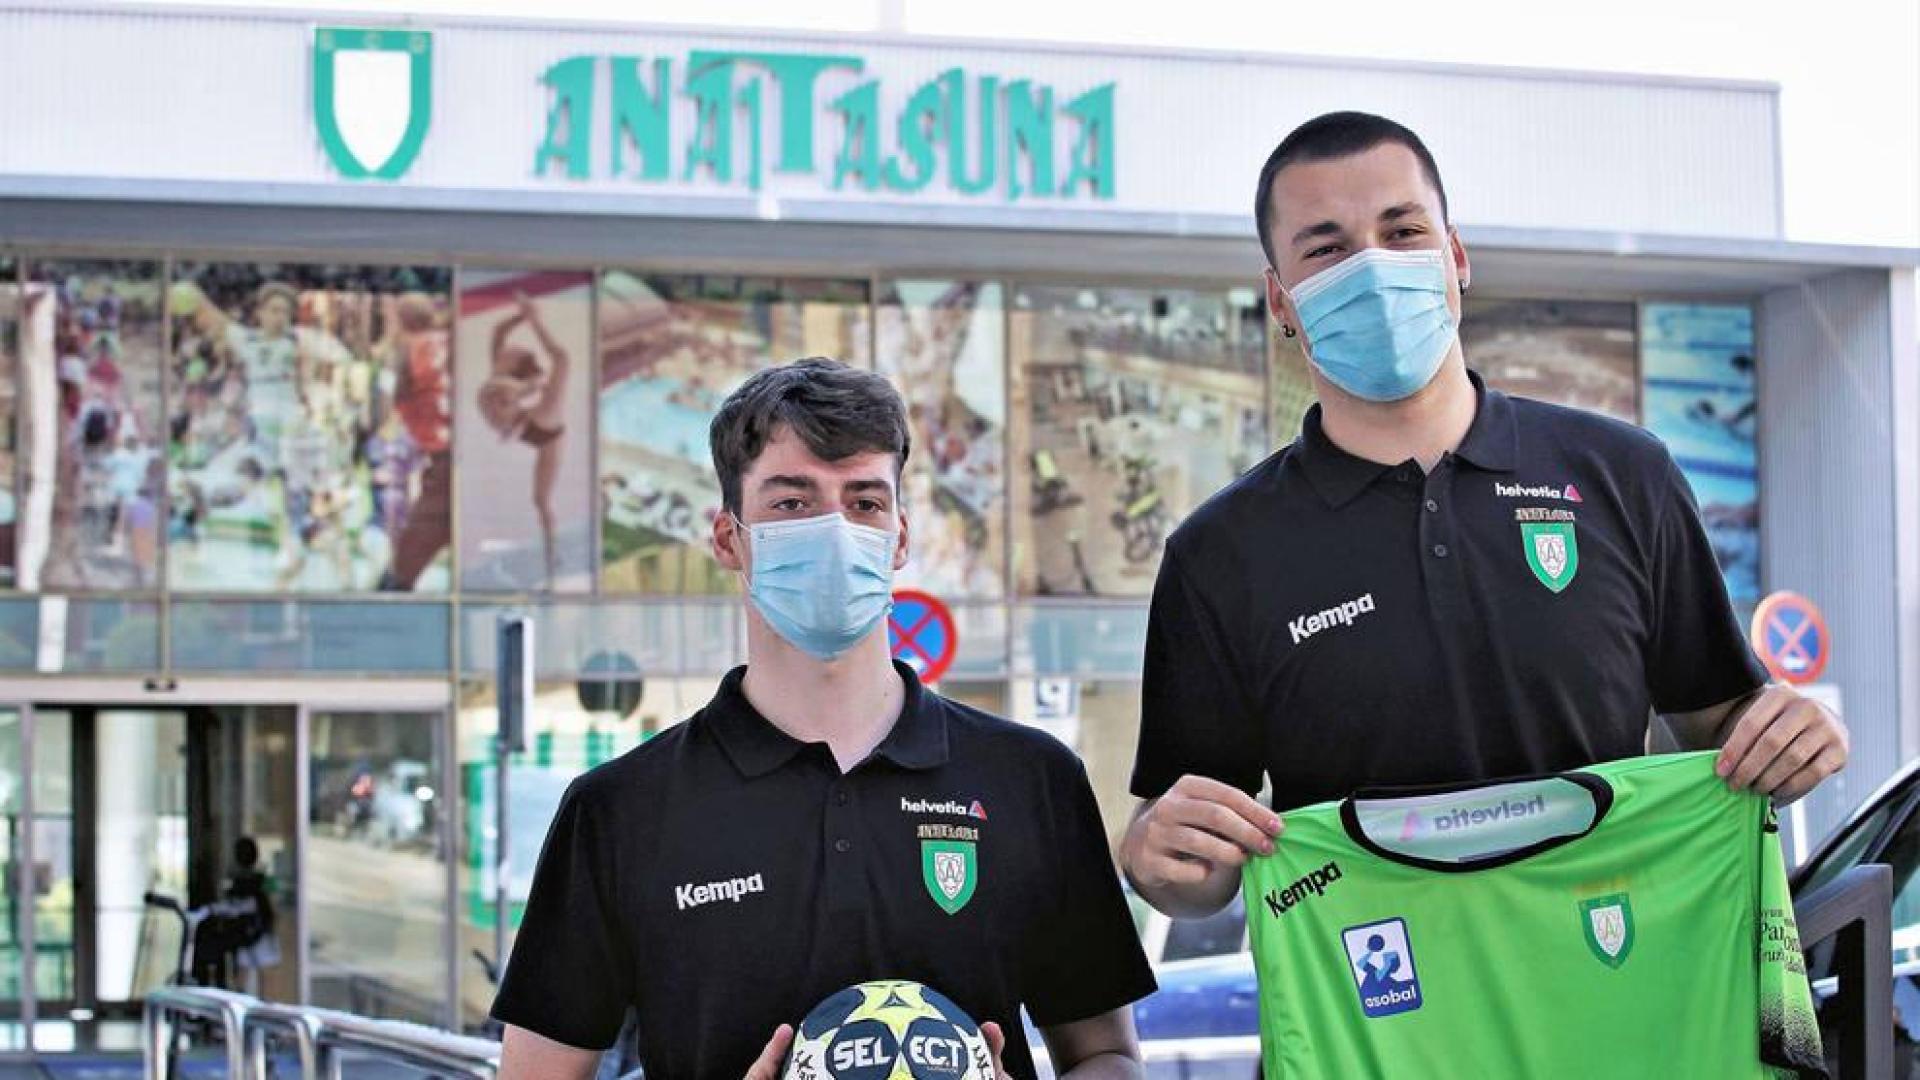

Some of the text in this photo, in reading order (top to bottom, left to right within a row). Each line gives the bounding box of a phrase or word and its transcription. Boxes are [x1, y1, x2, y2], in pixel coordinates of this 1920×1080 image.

[1494, 482, 1562, 499] helvetia
[1287, 593, 1376, 645] Kempa
[901, 797, 967, 815] helvetia
[675, 873, 765, 910] Kempa
[1264, 861, 1343, 918] Kempa
[1364, 984, 1417, 1008] asobal
